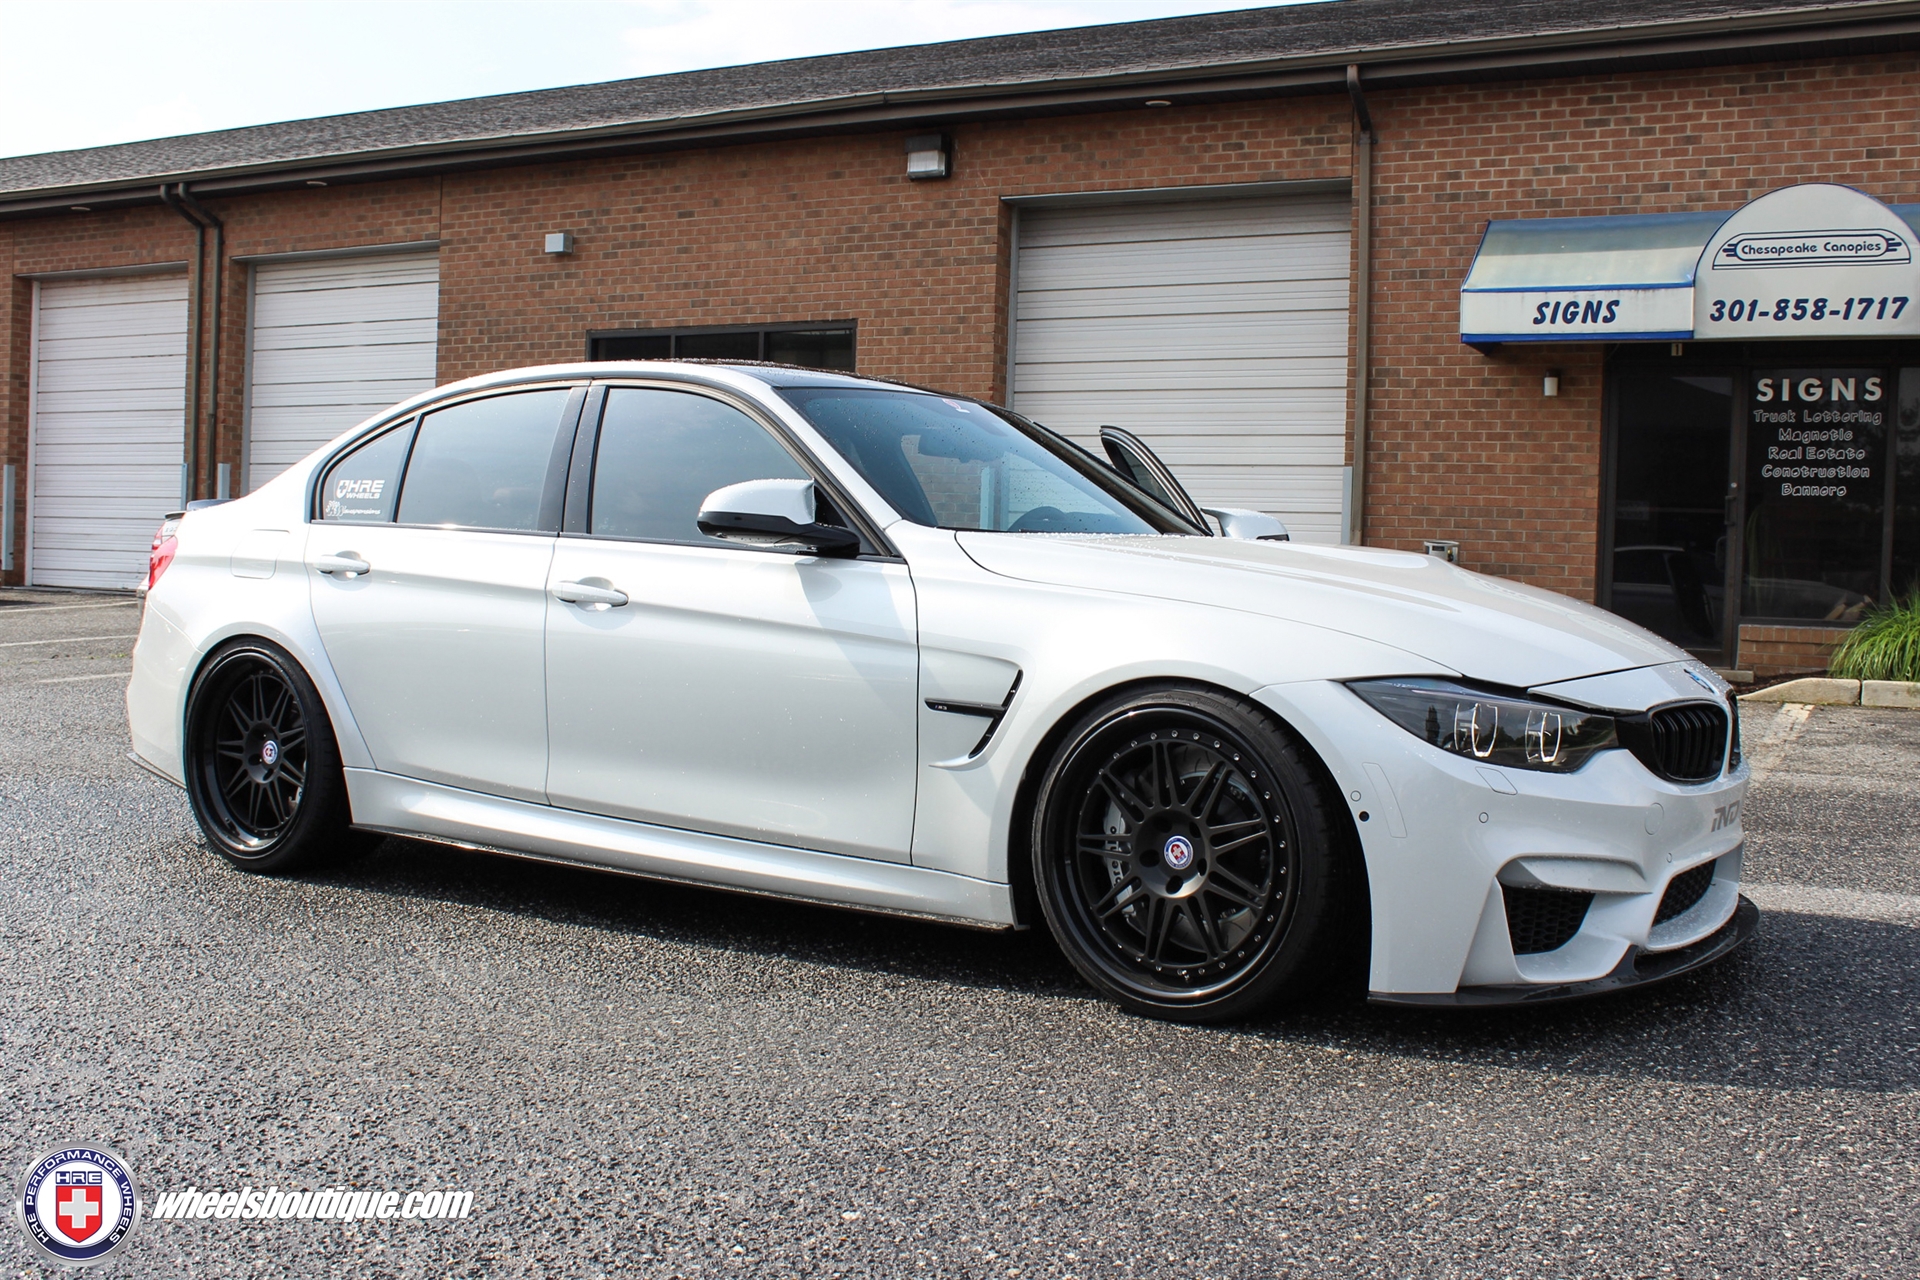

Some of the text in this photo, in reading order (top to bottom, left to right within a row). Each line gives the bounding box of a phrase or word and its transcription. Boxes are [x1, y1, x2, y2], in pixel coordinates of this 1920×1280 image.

[1741, 240, 1882, 257] Chesapeake Canopies
[1533, 299, 1620, 325] SIGNS
[1710, 296, 1910, 322] 301-858-1717
[1756, 377, 1882, 402] SIGNS
[1753, 410, 1882, 425] Truck Lettering
[1778, 428, 1853, 443] Magnetic
[1768, 446, 1866, 460] Real Estate
[1761, 464, 1870, 478] Construction
[347, 479, 385, 492] HRE
[1781, 483, 1847, 496] Banners
